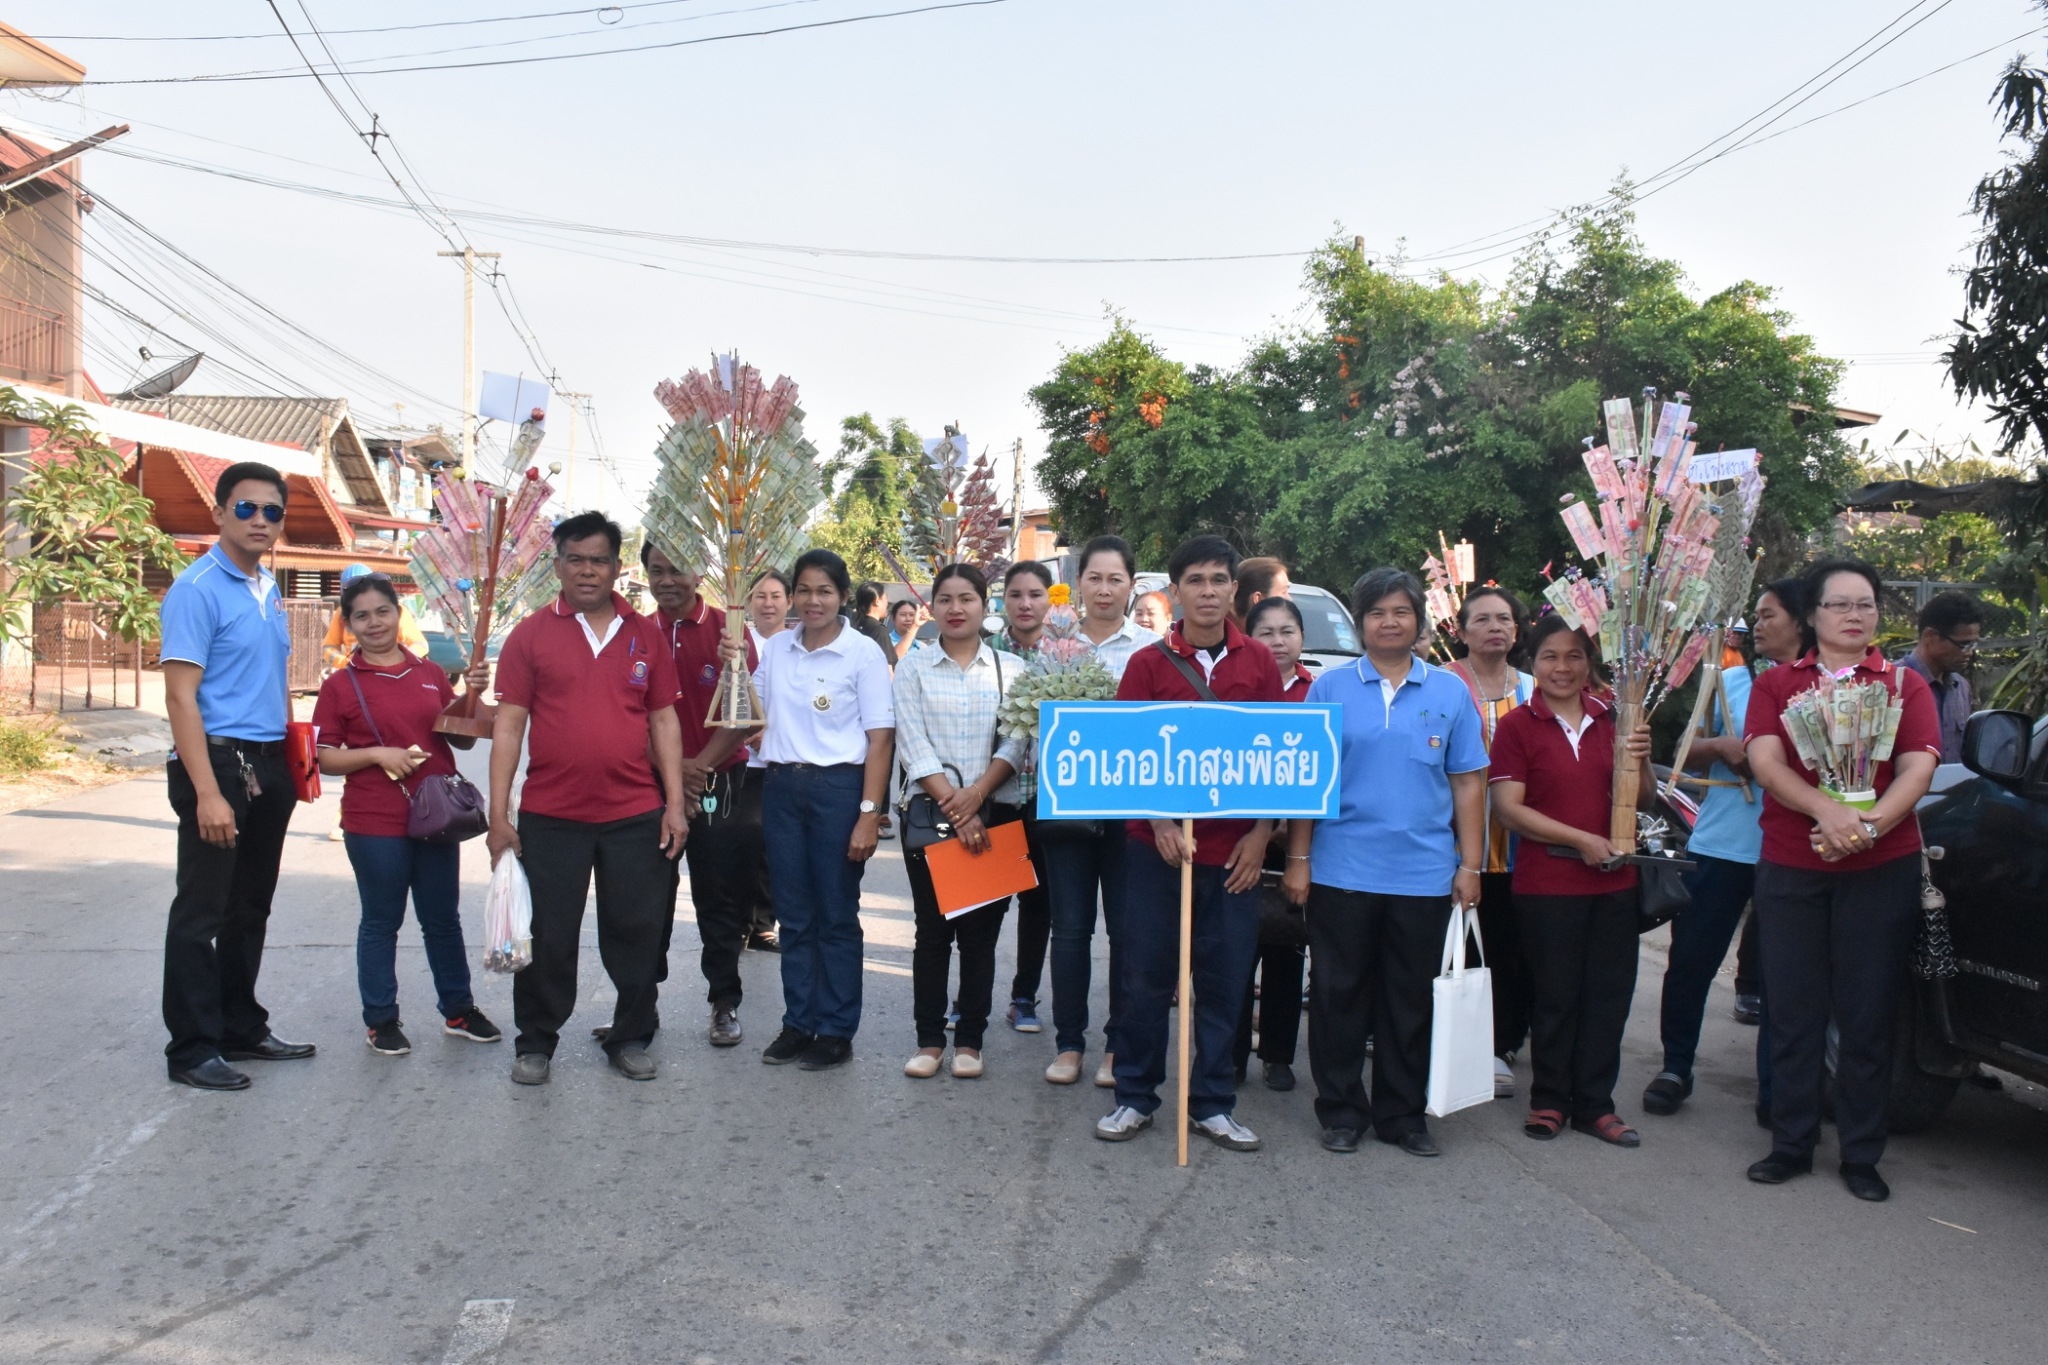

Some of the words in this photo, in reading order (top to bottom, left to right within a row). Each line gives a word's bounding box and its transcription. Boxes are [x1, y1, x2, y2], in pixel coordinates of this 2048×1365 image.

[1056, 724, 1319, 807] อำเภอโกสุมพิสัย
[1975, 963, 2039, 991] COLORADO
